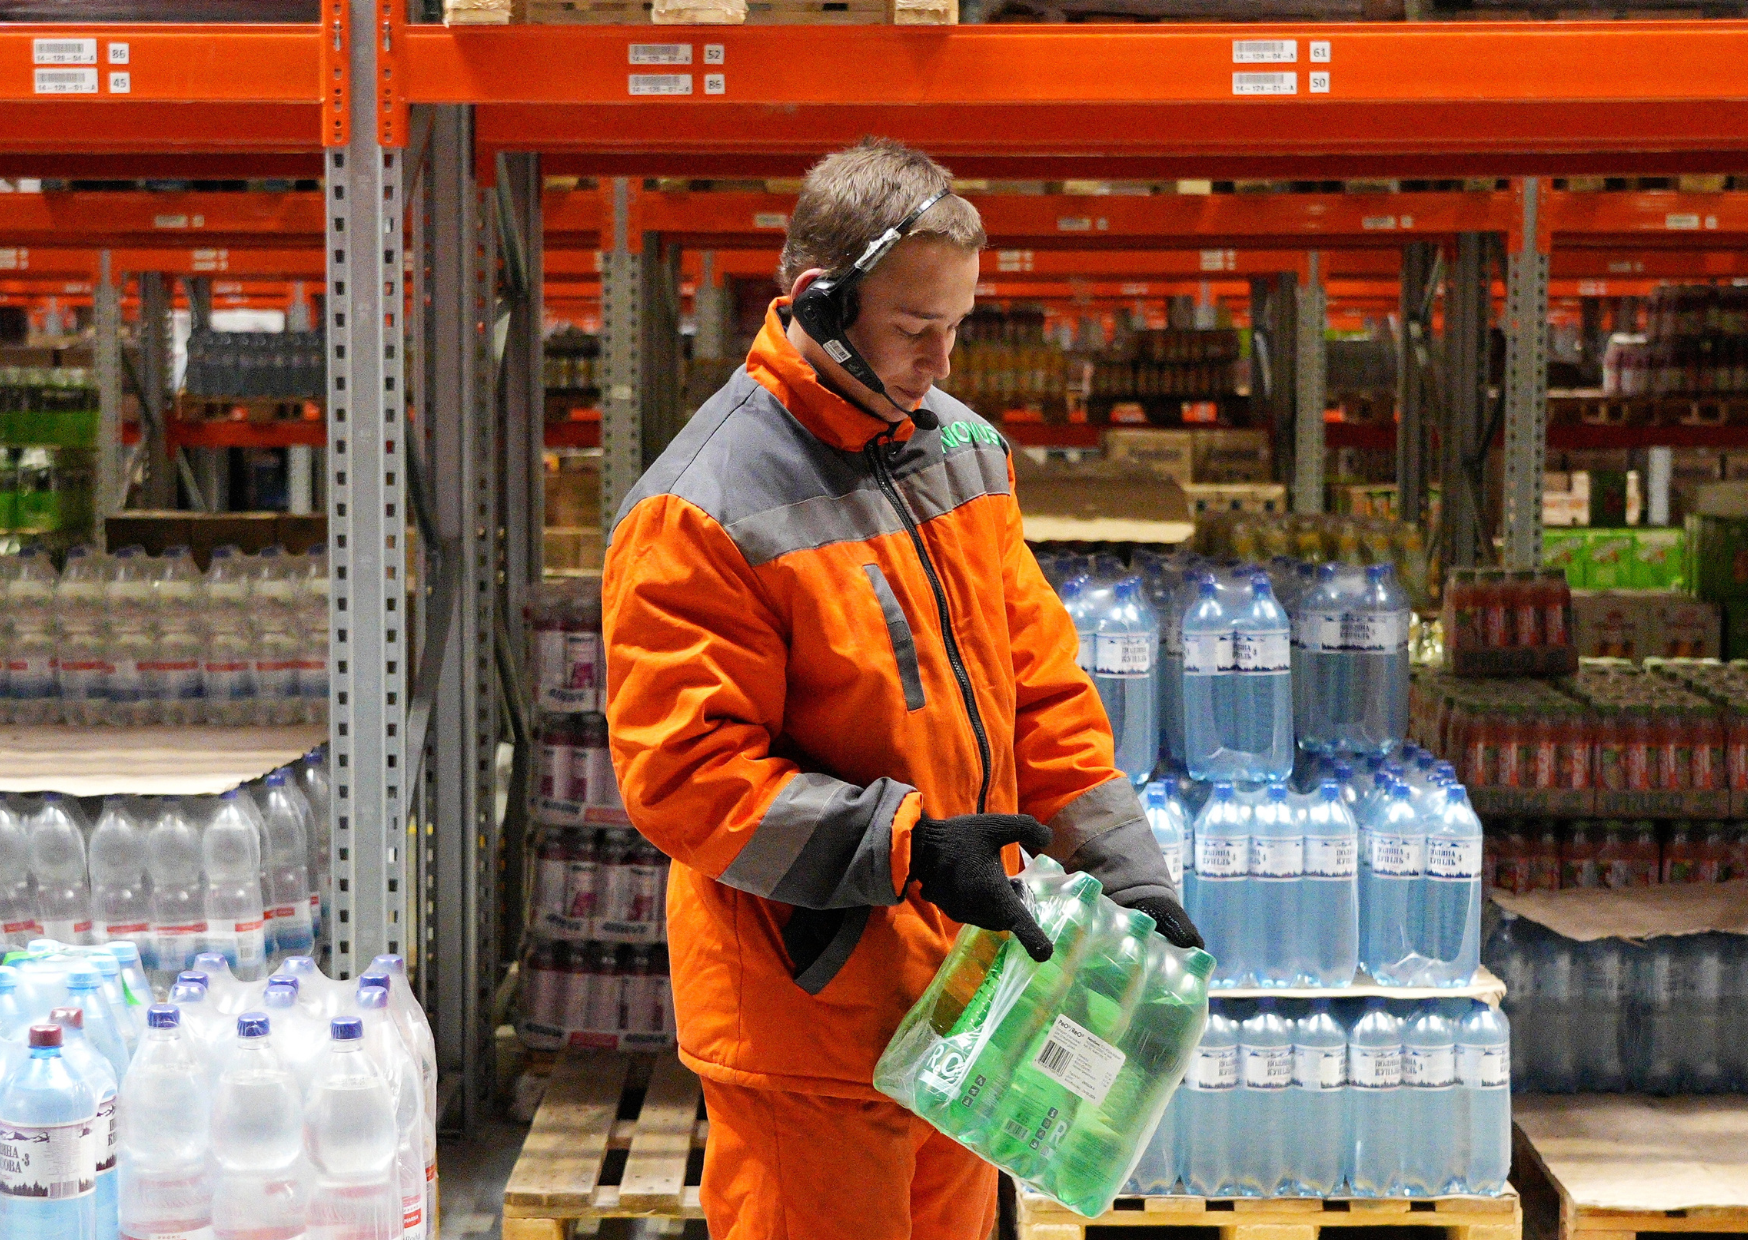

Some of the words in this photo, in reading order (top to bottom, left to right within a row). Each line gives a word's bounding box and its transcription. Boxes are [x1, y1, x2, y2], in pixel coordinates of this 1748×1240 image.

[707, 49, 721, 60] 52
[1313, 48, 1327, 58] 61
[113, 78, 127, 88] 45
[708, 80, 722, 90] 86
[1312, 78, 1326, 88] 50
